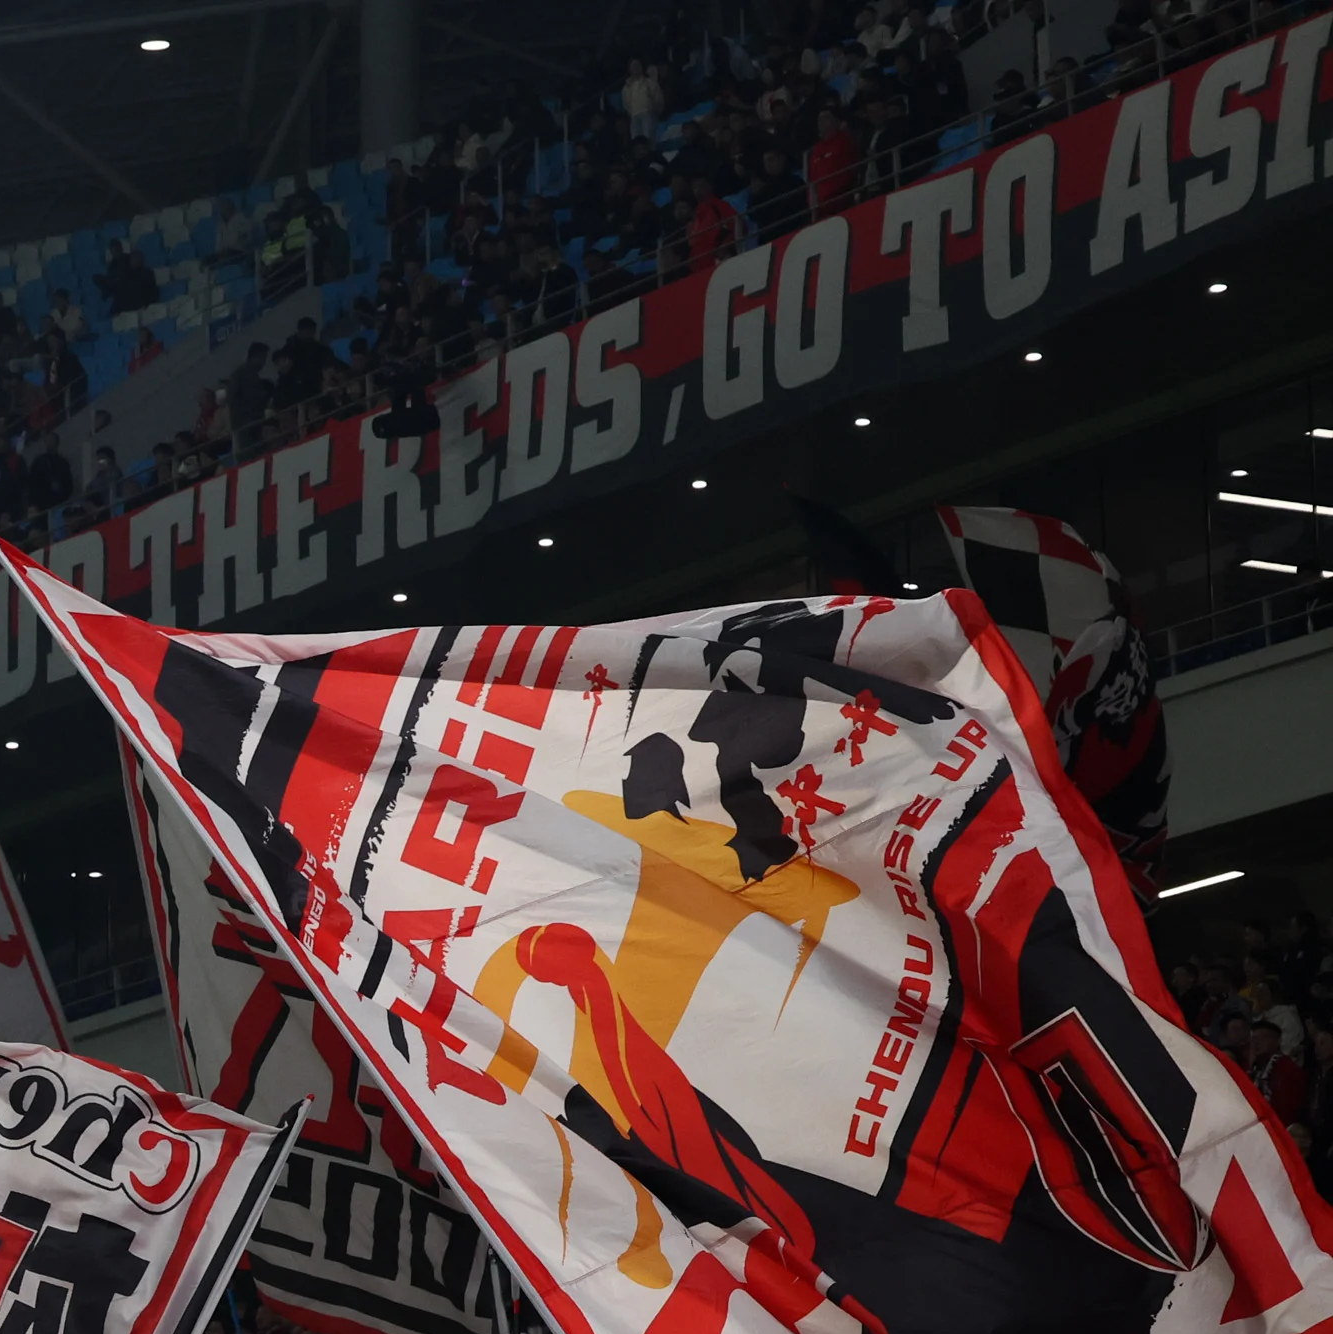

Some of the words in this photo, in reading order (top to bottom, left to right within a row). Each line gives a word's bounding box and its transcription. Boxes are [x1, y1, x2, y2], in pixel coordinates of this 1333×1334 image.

[130, 434, 331, 626] THE
[355, 298, 684, 566] REDS,
[702, 216, 849, 420] GO
[881, 133, 1055, 352] TO
[1089, 12, 1333, 275] ASI
[932, 718, 988, 782] UP
[884, 793, 941, 922] RISE
[844, 934, 934, 1158] CHENGDU
